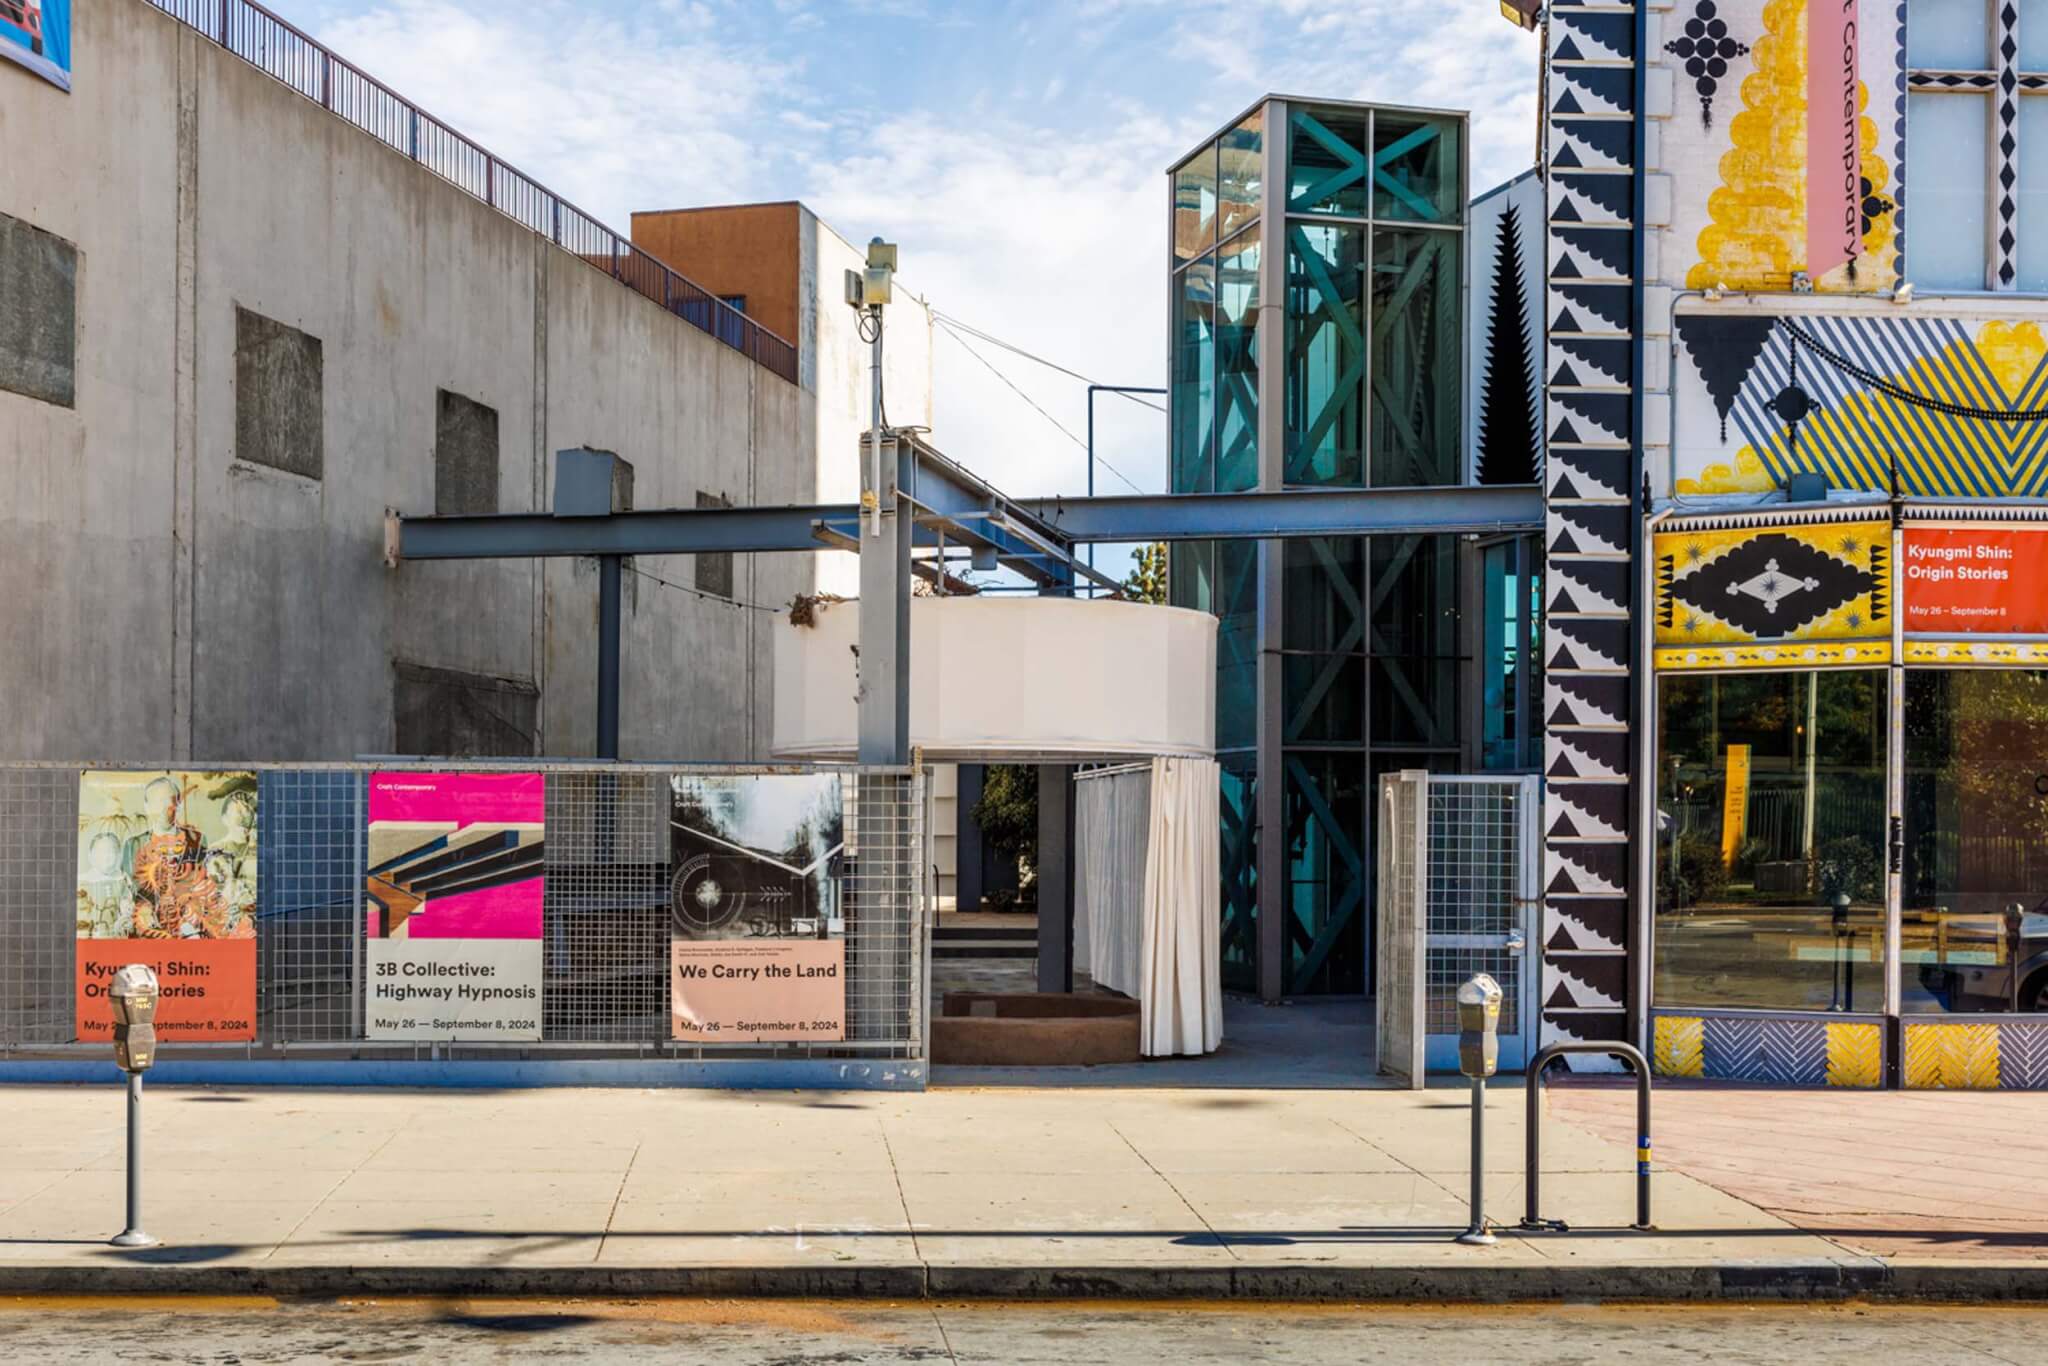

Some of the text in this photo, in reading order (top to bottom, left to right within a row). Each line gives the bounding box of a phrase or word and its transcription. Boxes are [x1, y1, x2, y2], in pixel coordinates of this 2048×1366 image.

[1842, 21, 1858, 260] Contemporary
[1908, 544, 2013, 561] Kyungmi Shin:
[1908, 565, 2008, 581] Origin Stories
[1909, 605, 1928, 616] May
[1930, 606, 1941, 615] 26
[1951, 606, 1998, 617] September
[167, 961, 210, 976] Shin:
[376, 962, 495, 977] 3B Collective:
[679, 963, 837, 981] We Carry the Land
[158, 983, 205, 998] tories
[376, 984, 536, 1001] Highway Hypnosis
[84, 1020, 108, 1032] May
[208, 1020, 218, 1032] 8,
[221, 1020, 249, 1030] 2024
[375, 1019, 399, 1031] May
[402, 1019, 416, 1029] 26
[433, 1019, 492, 1031] September
[495, 1019, 506, 1031] 8,
[508, 1019, 535, 1030] 2024
[681, 1021, 704, 1033] May
[706, 1021, 720, 1032] 26
[736, 1021, 796, 1033] September
[799, 1021, 809, 1032] 8,
[812, 1020, 839, 1031] 2024
